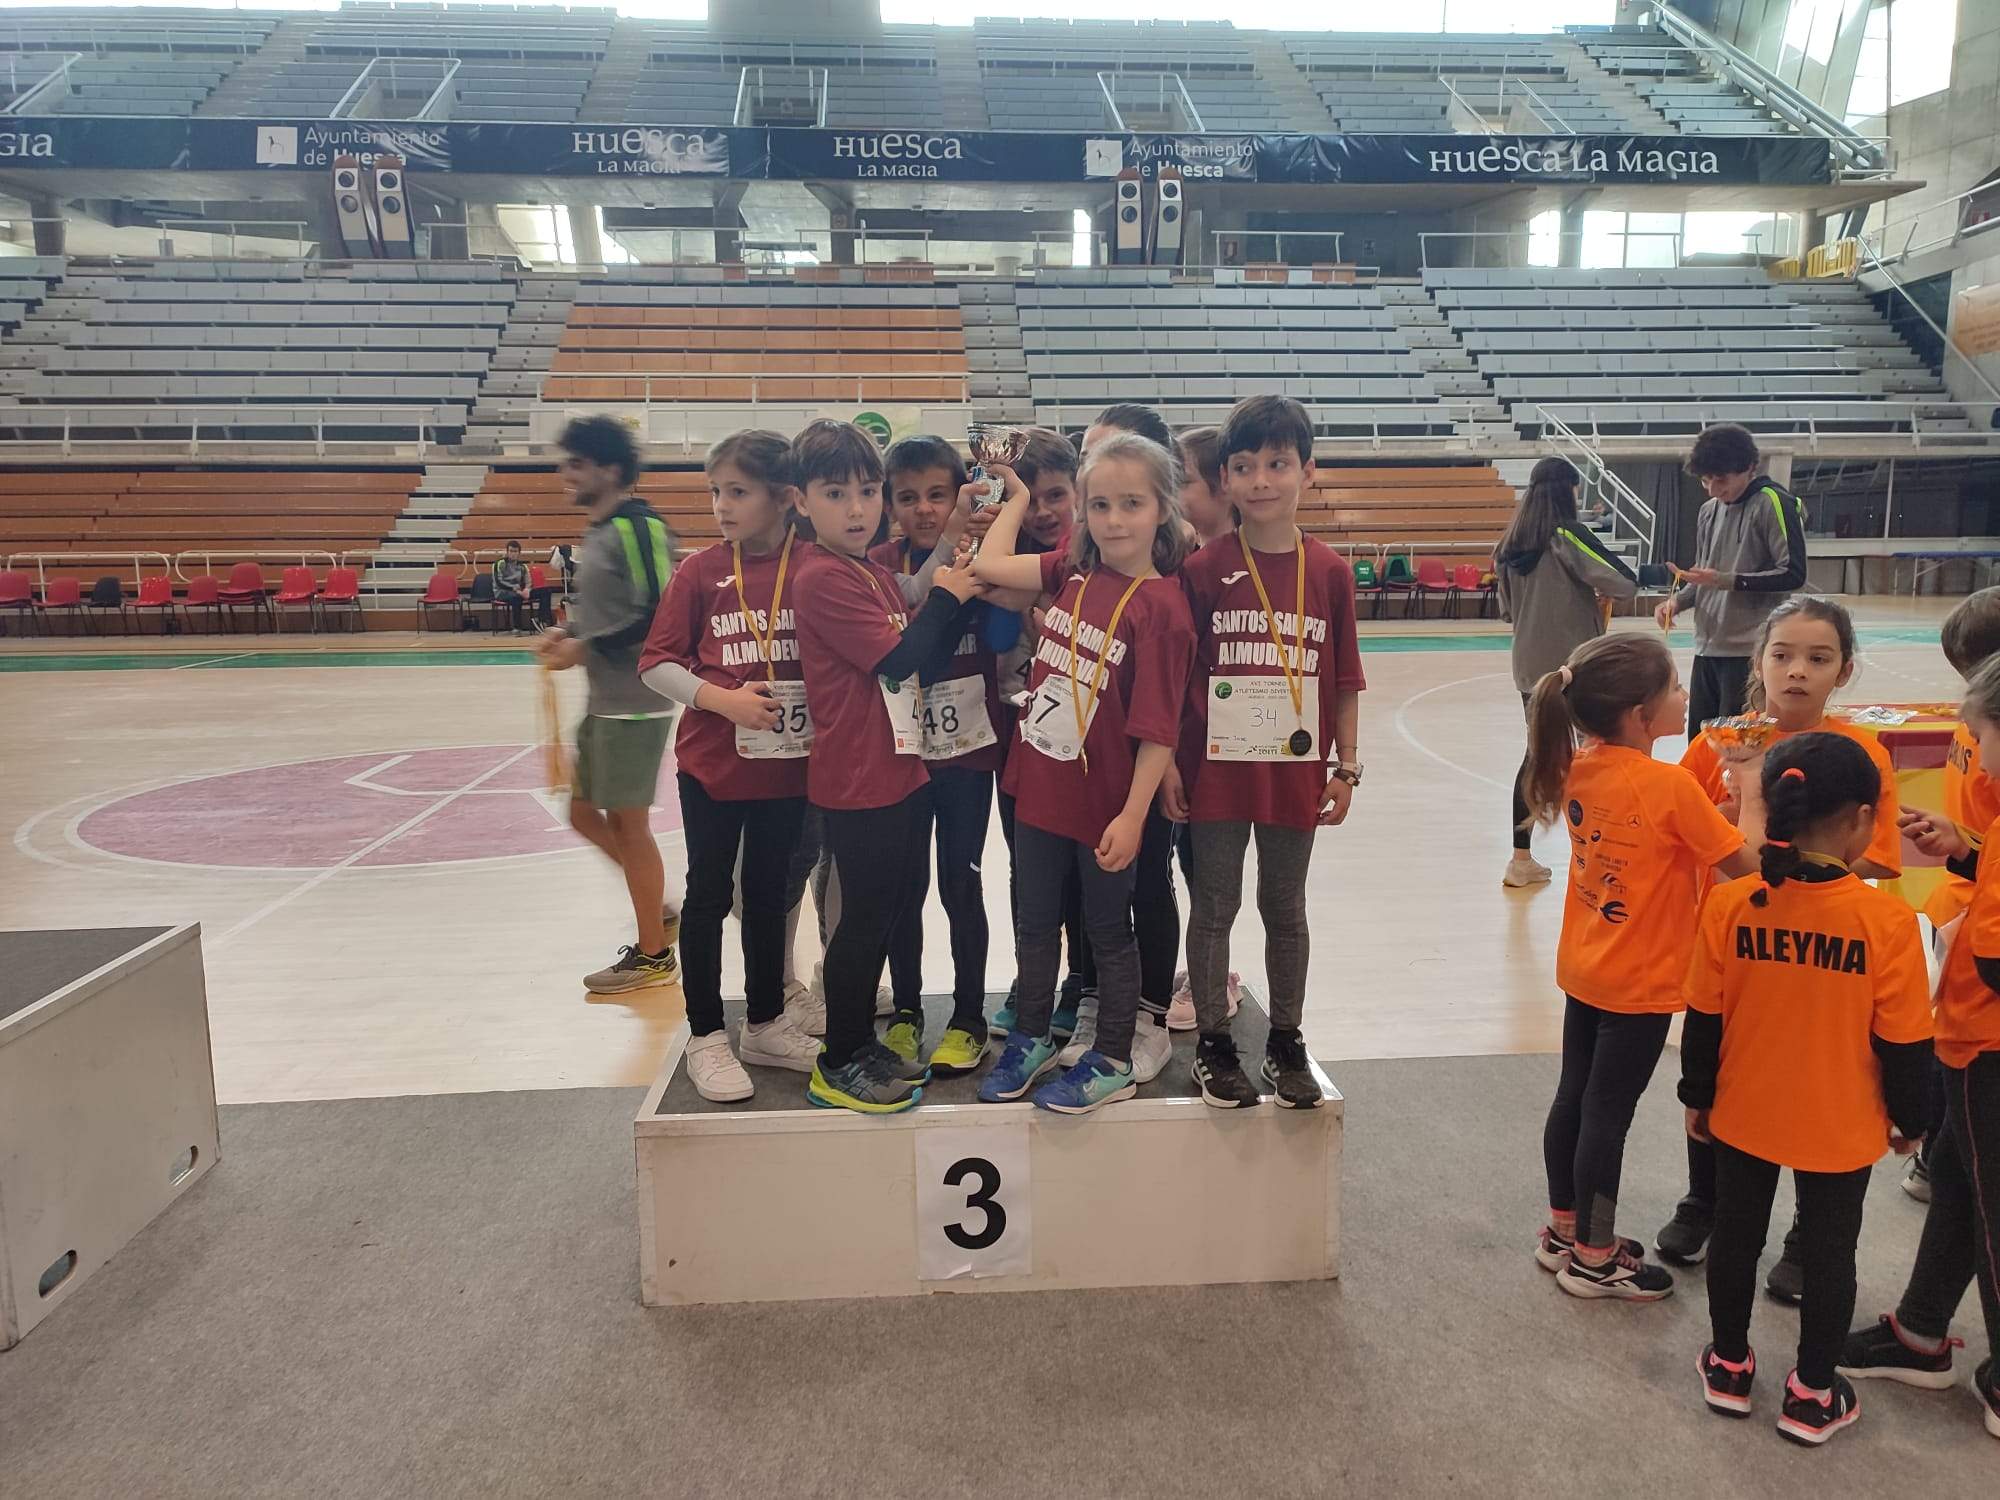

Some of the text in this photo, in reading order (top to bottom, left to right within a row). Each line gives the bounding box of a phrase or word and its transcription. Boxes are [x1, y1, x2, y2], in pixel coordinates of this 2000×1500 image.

[304, 127, 441, 148] Ayuntamiento
[571, 129, 705, 156] Huesca
[833, 133, 963, 159] Huesca
[303, 149, 327, 165] de
[1130, 141, 1253, 161] Ayuntamiento
[1429, 145, 1560, 172] Huesca
[1572, 148, 1609, 172] La
[598, 160, 618, 173] La
[857, 164, 878, 177] La
[711, 609, 768, 638] SANTOS
[1212, 610, 1268, 634] SANTOS
[771, 704, 806, 734] 35
[922, 704, 959, 735] 48
[1250, 707, 1277, 728] 34
[1737, 926, 1866, 975] ALEYMA
[943, 1157, 1007, 1250] 3
